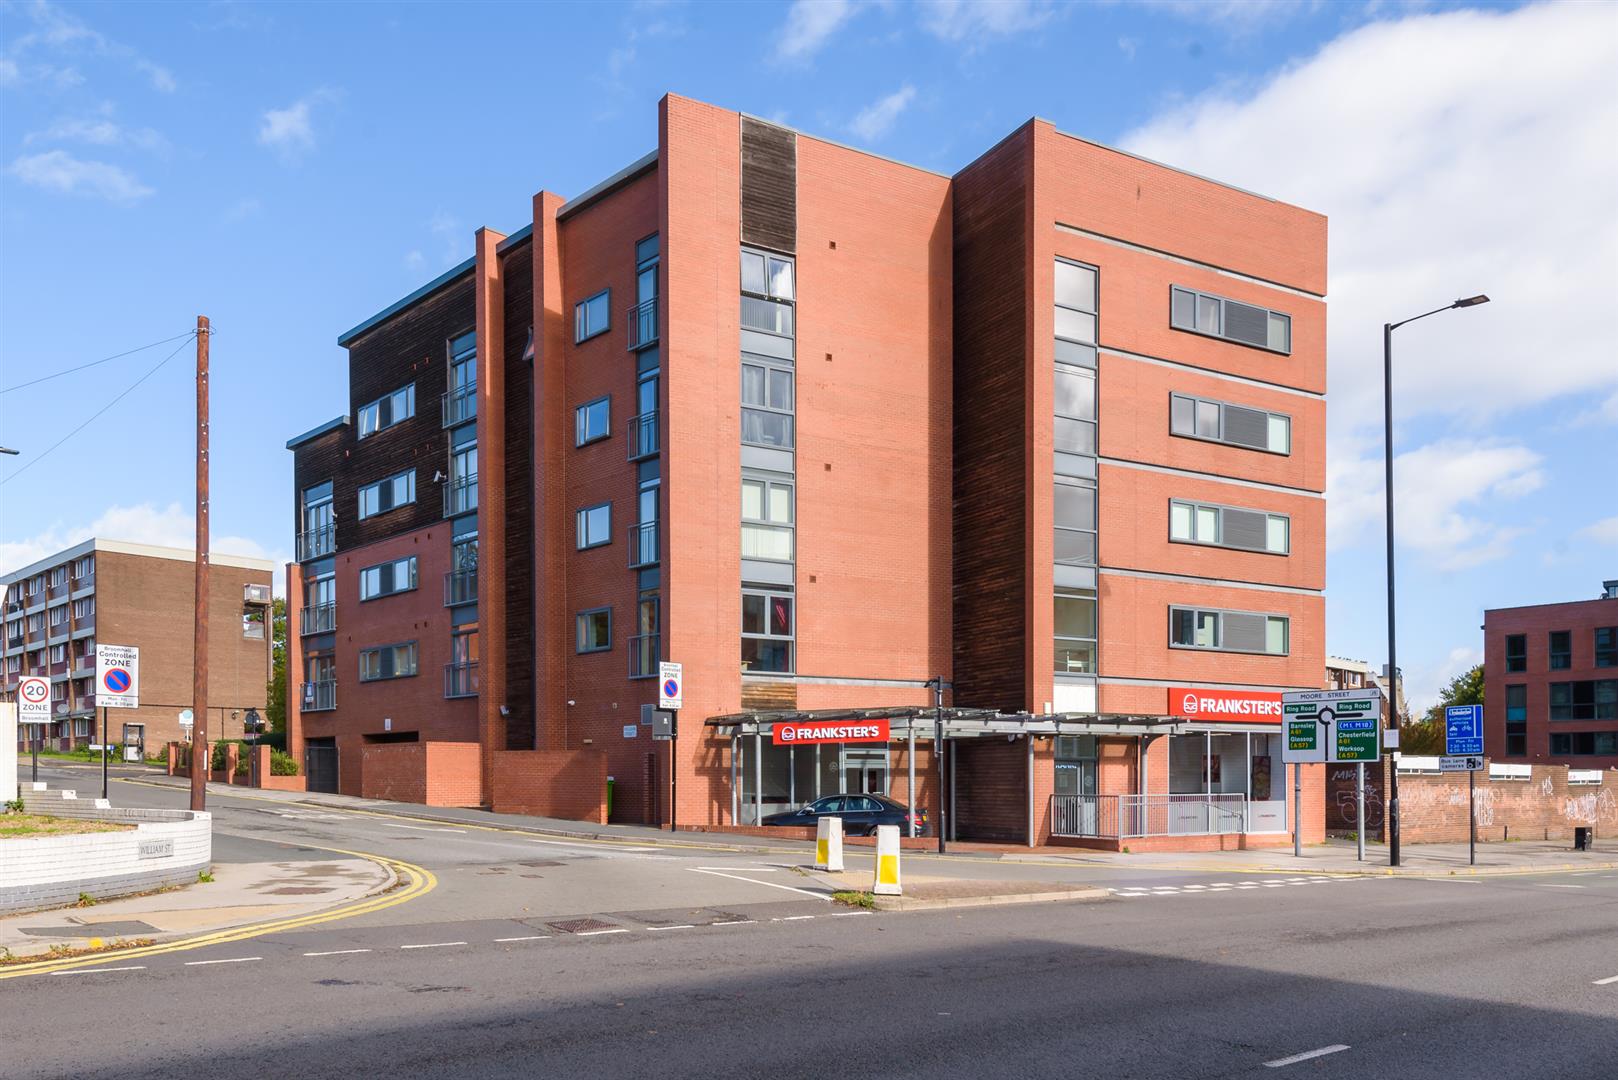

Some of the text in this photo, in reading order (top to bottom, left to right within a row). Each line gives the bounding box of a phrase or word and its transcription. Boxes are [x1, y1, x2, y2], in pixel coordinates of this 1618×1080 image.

[99, 651, 137, 660] Controlled
[26, 686, 45, 696] 20
[1200, 698, 1282, 714] FRANKSTER'S
[797, 726, 879, 740] FRANKSTER'S
[140, 844, 163, 854] WILLIAM
